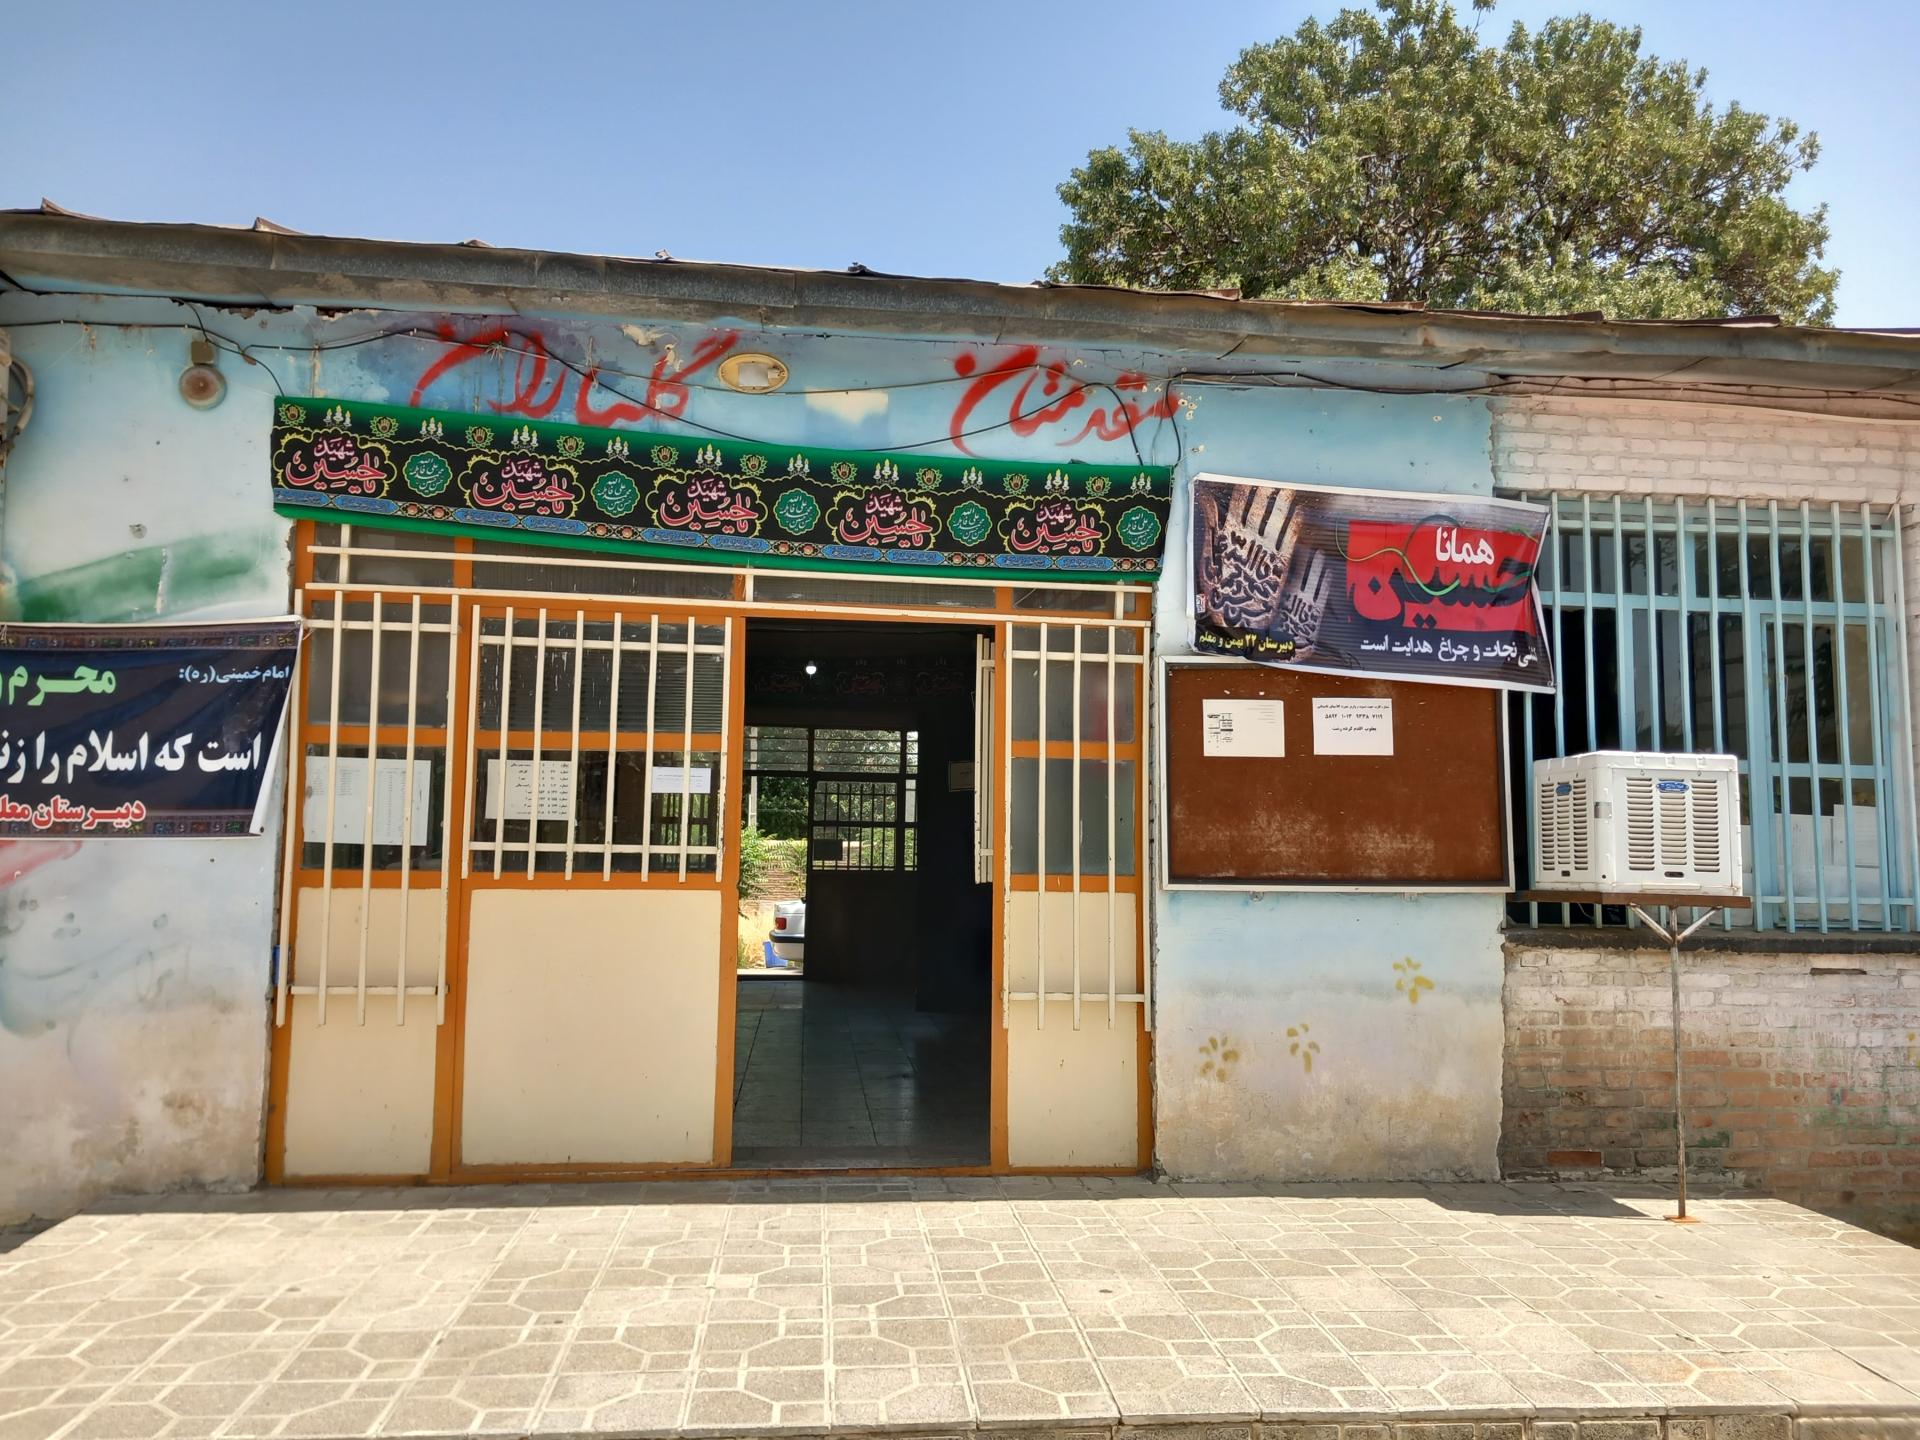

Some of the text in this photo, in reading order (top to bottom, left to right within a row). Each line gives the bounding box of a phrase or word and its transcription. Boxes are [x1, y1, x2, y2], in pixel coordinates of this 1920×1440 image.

[314, 437, 355, 460] شهید
[501, 459, 542, 482] شهید
[687, 478, 727, 502] شهید
[865, 494, 903, 517] شهید
[1036, 502, 1073, 524] شهید
[1435, 526, 1495, 565] همانا
[1199, 631, 1294, 653] دبیرستان ۲۲ بهمن و معلم
[1360, 635, 1389, 652] است
[1392, 636, 1433, 656] هدایت
[1438, 637, 1469, 661] چراغ
[1474, 644, 1481, 657] و
[1483, 640, 1518, 660] نجات
[8, 665, 118, 706] محرم
[262, 665, 290, 683] امام
[36, 730, 60, 784] را
[67, 729, 149, 784] اسلام
[154, 732, 194, 772] که
[198, 731, 262, 772] است
[0, 794, 146, 829] دبیرستان معل
